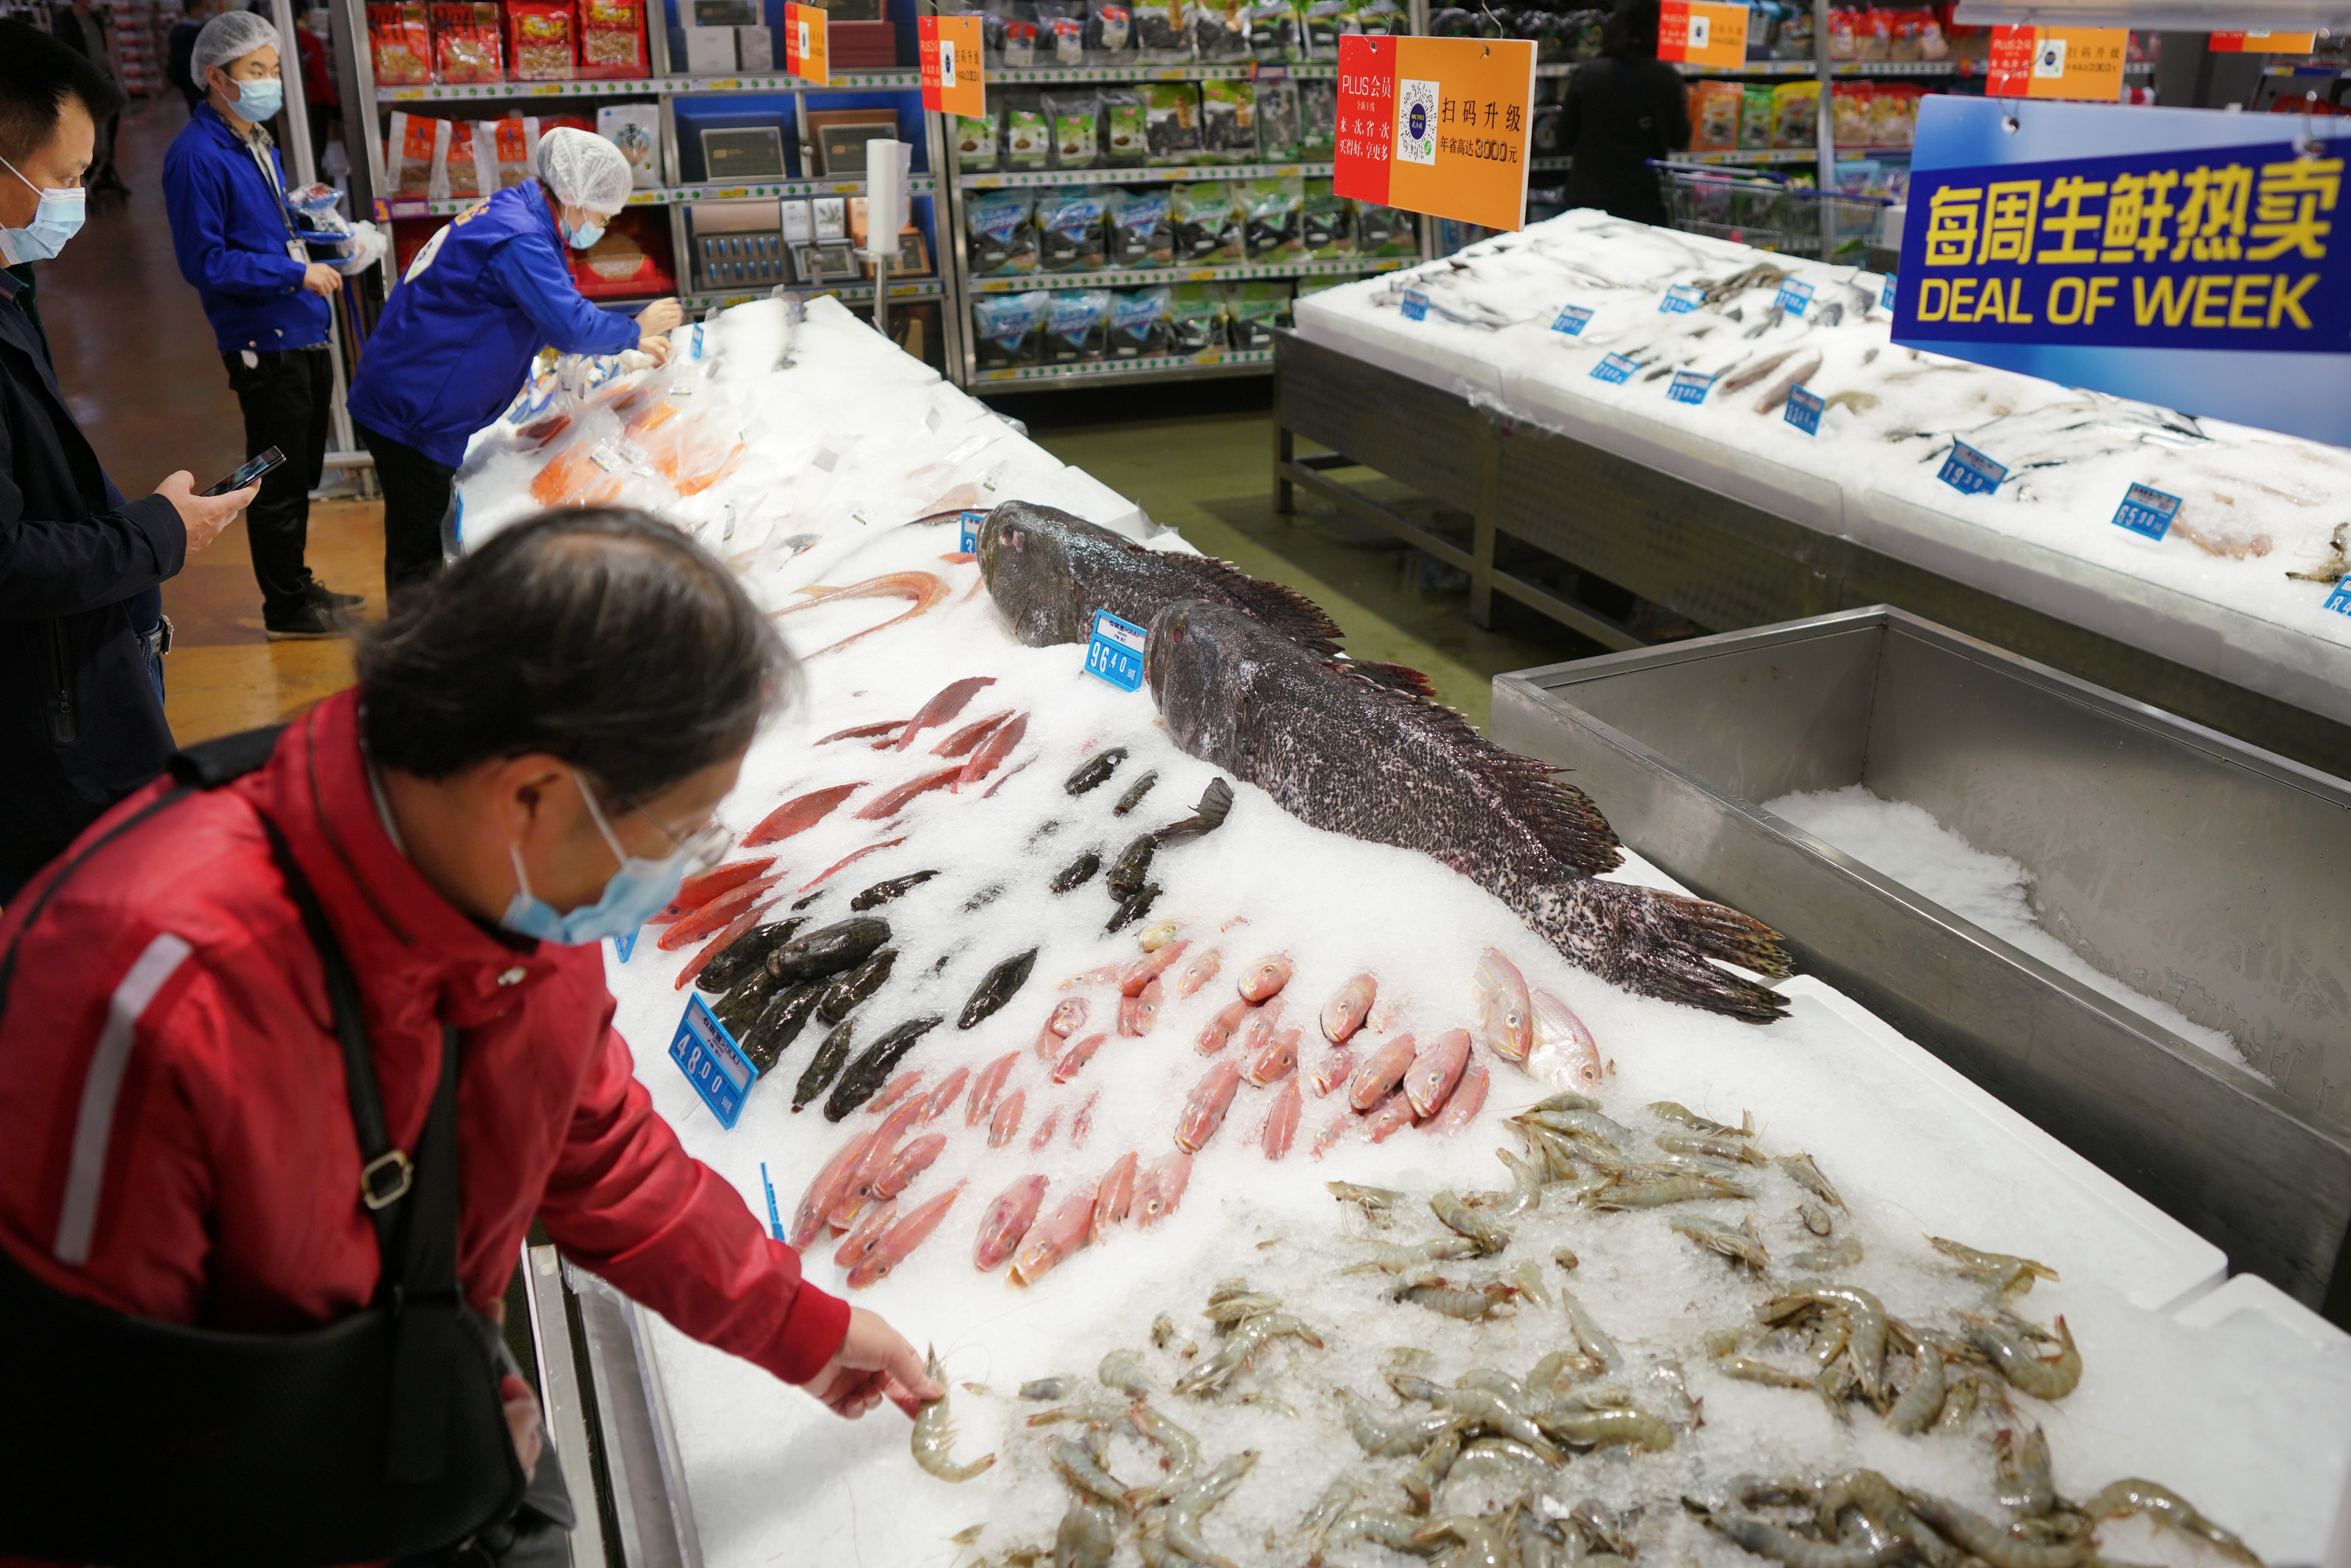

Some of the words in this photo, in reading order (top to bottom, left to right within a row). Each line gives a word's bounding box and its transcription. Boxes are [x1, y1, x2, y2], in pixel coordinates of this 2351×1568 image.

[1342, 74, 1391, 99] PLUS会员
[1442, 96, 1521, 132] 扫码升级
[1440, 136, 1518, 163] 年省高达3000元
[1925, 158, 2345, 266] 每周生鲜热卖
[1917, 277, 2034, 324] DEAL
[2046, 277, 2119, 325] OF
[2132, 273, 2320, 330] WEEK
[1090, 641, 1127, 673] 96.40
[677, 1033, 723, 1094] 48.00
